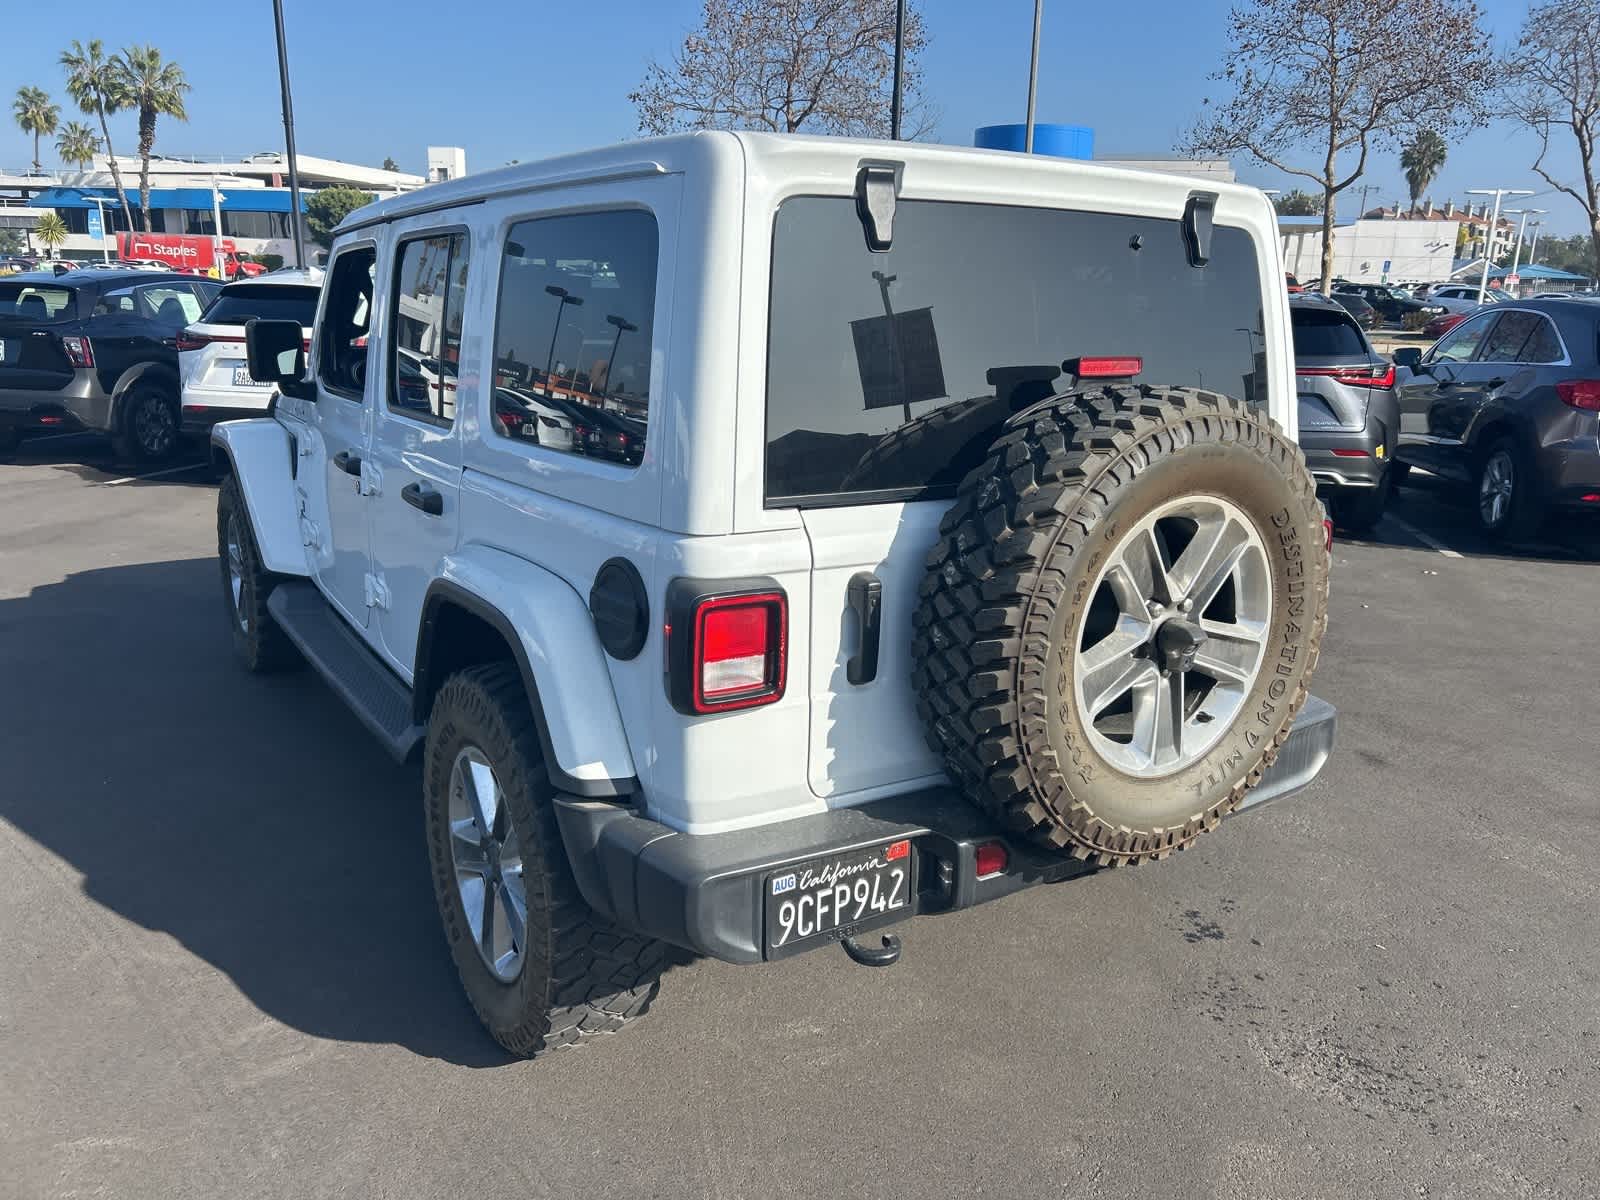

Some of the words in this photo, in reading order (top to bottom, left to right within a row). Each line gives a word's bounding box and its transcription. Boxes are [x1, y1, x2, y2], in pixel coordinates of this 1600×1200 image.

[154, 244, 197, 258] Staples
[1256, 507, 1305, 727] DESTINATION
[774, 875, 795, 893] AUG
[799, 856, 888, 890] California
[778, 869, 904, 946] 9CFP942
